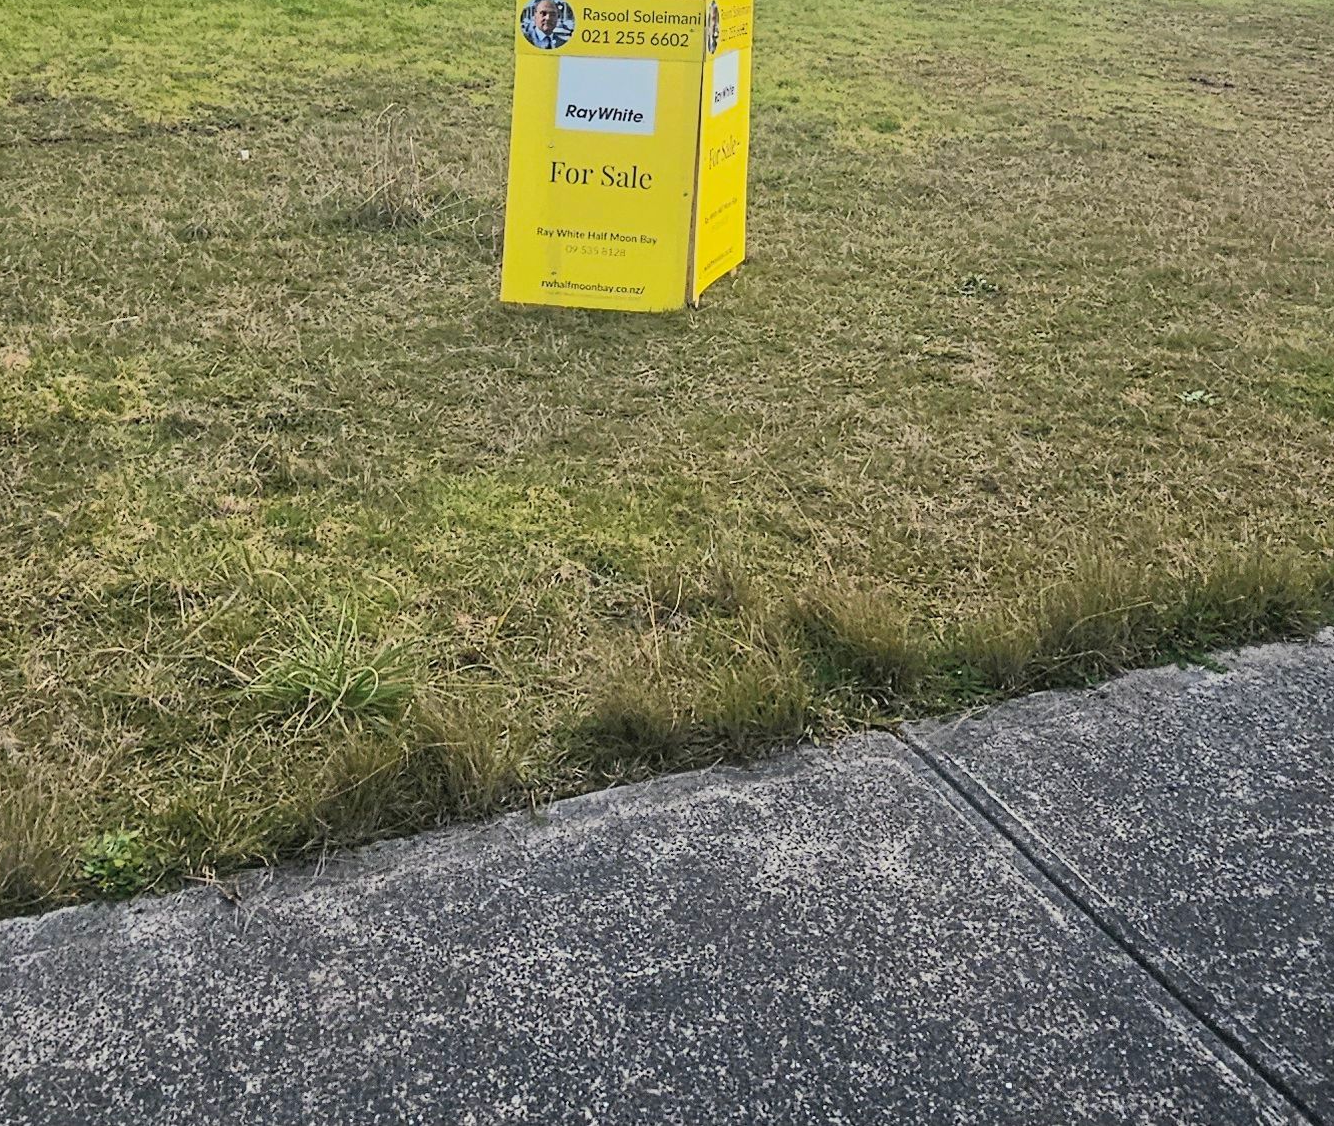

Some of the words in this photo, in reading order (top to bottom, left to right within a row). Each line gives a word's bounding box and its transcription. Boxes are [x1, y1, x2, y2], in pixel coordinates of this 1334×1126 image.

[583, 7, 629, 23] Rasool
[634, 9, 701, 25] Soleimani
[581, 29, 610, 44] 021
[615, 30, 645, 45] 255
[650, 32, 689, 47] 6602
[549, 161, 594, 184] For
[600, 164, 652, 190] Sale
[537, 227, 555, 238] Ray
[556, 229, 585, 239] White
[588, 231, 608, 240] Half
[610, 232, 637, 243] Moon
[640, 234, 658, 245] Bay
[541, 279, 645, 295] rwhalfmoonbay.co.nz/
